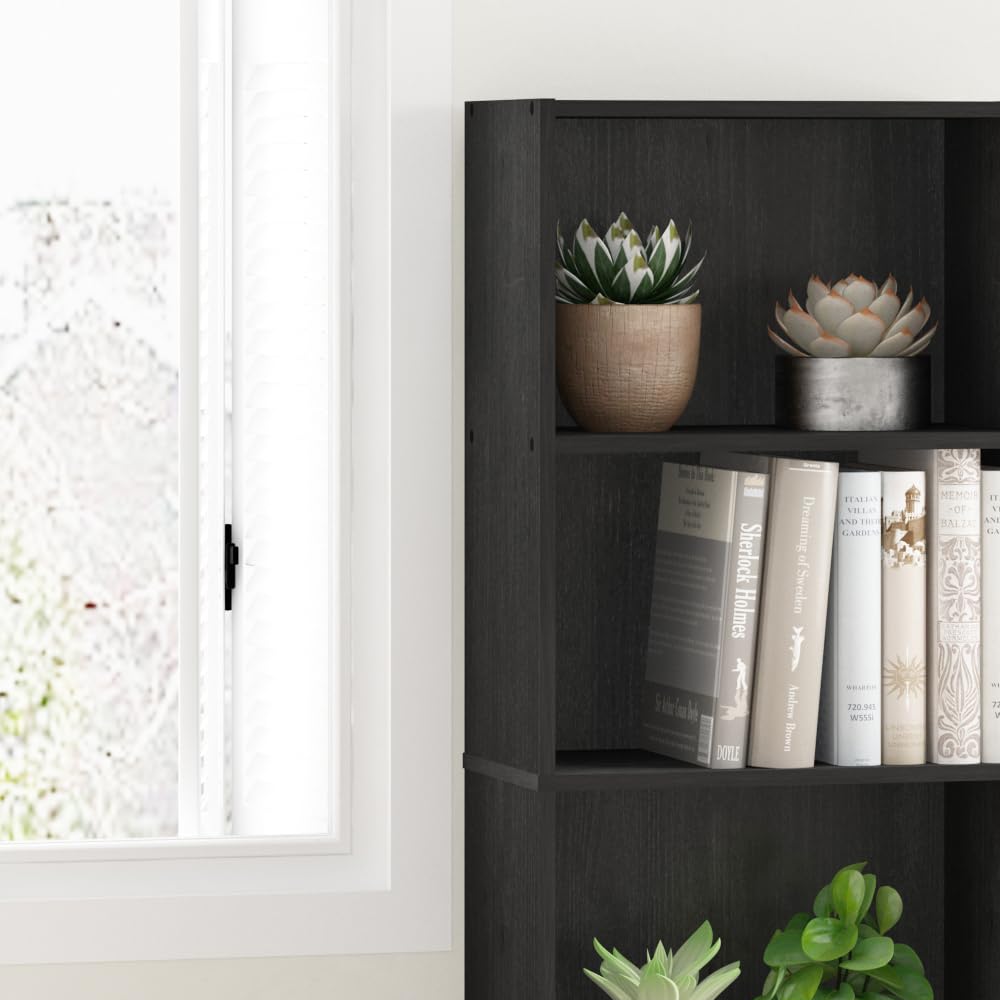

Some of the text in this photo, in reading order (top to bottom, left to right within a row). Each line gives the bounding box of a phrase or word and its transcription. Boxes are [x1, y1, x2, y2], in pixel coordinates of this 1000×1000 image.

[840, 518, 858, 526] AND
[736, 522, 762, 584] Sherlock
[794, 496, 816, 614] Dreaming of Sweden
[731, 587, 757, 639] Holmes
[784, 684, 799, 752] Andrew Brown
[716, 744, 740, 762] DOYLE
